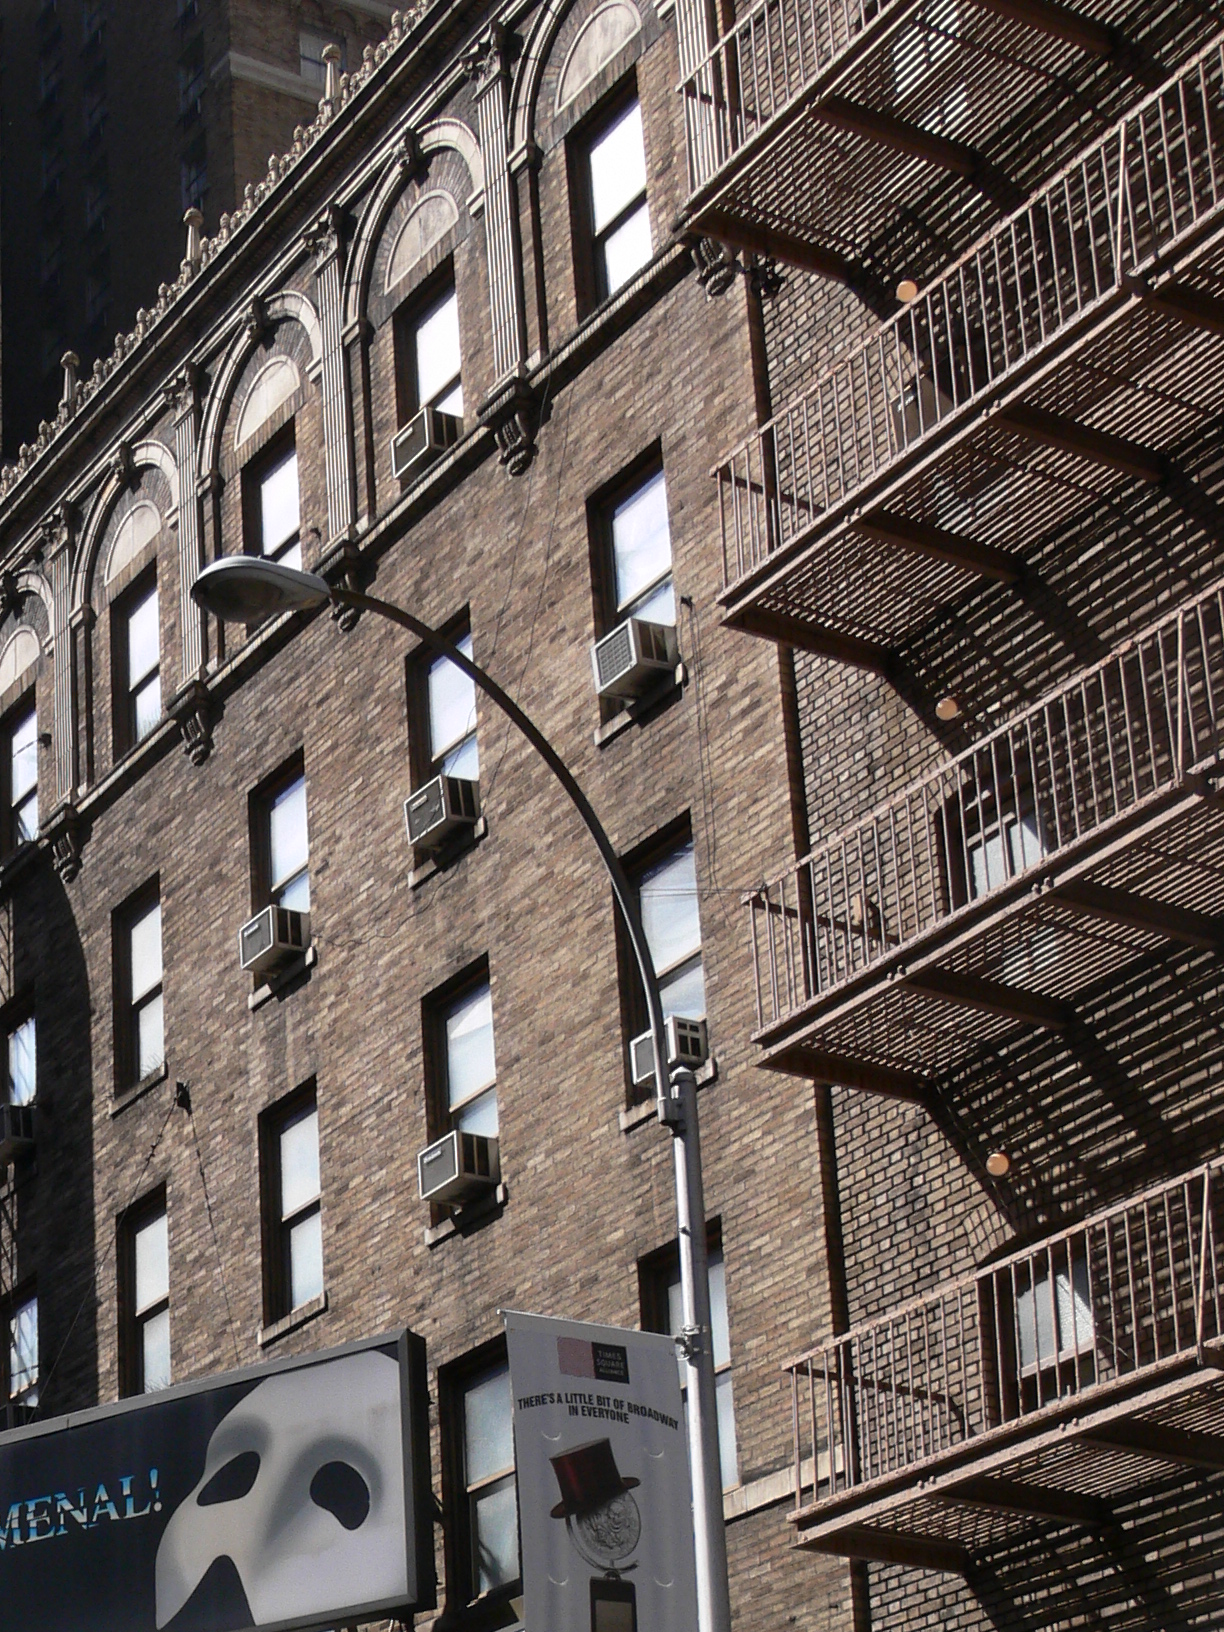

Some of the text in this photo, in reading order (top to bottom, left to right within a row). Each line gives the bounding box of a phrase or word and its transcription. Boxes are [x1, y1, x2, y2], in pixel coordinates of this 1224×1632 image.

[517, 1392, 679, 1431] THERE'S A LITTLE BIT OF BROADWAY
[568, 1405, 630, 1424] IN EVERYONE
